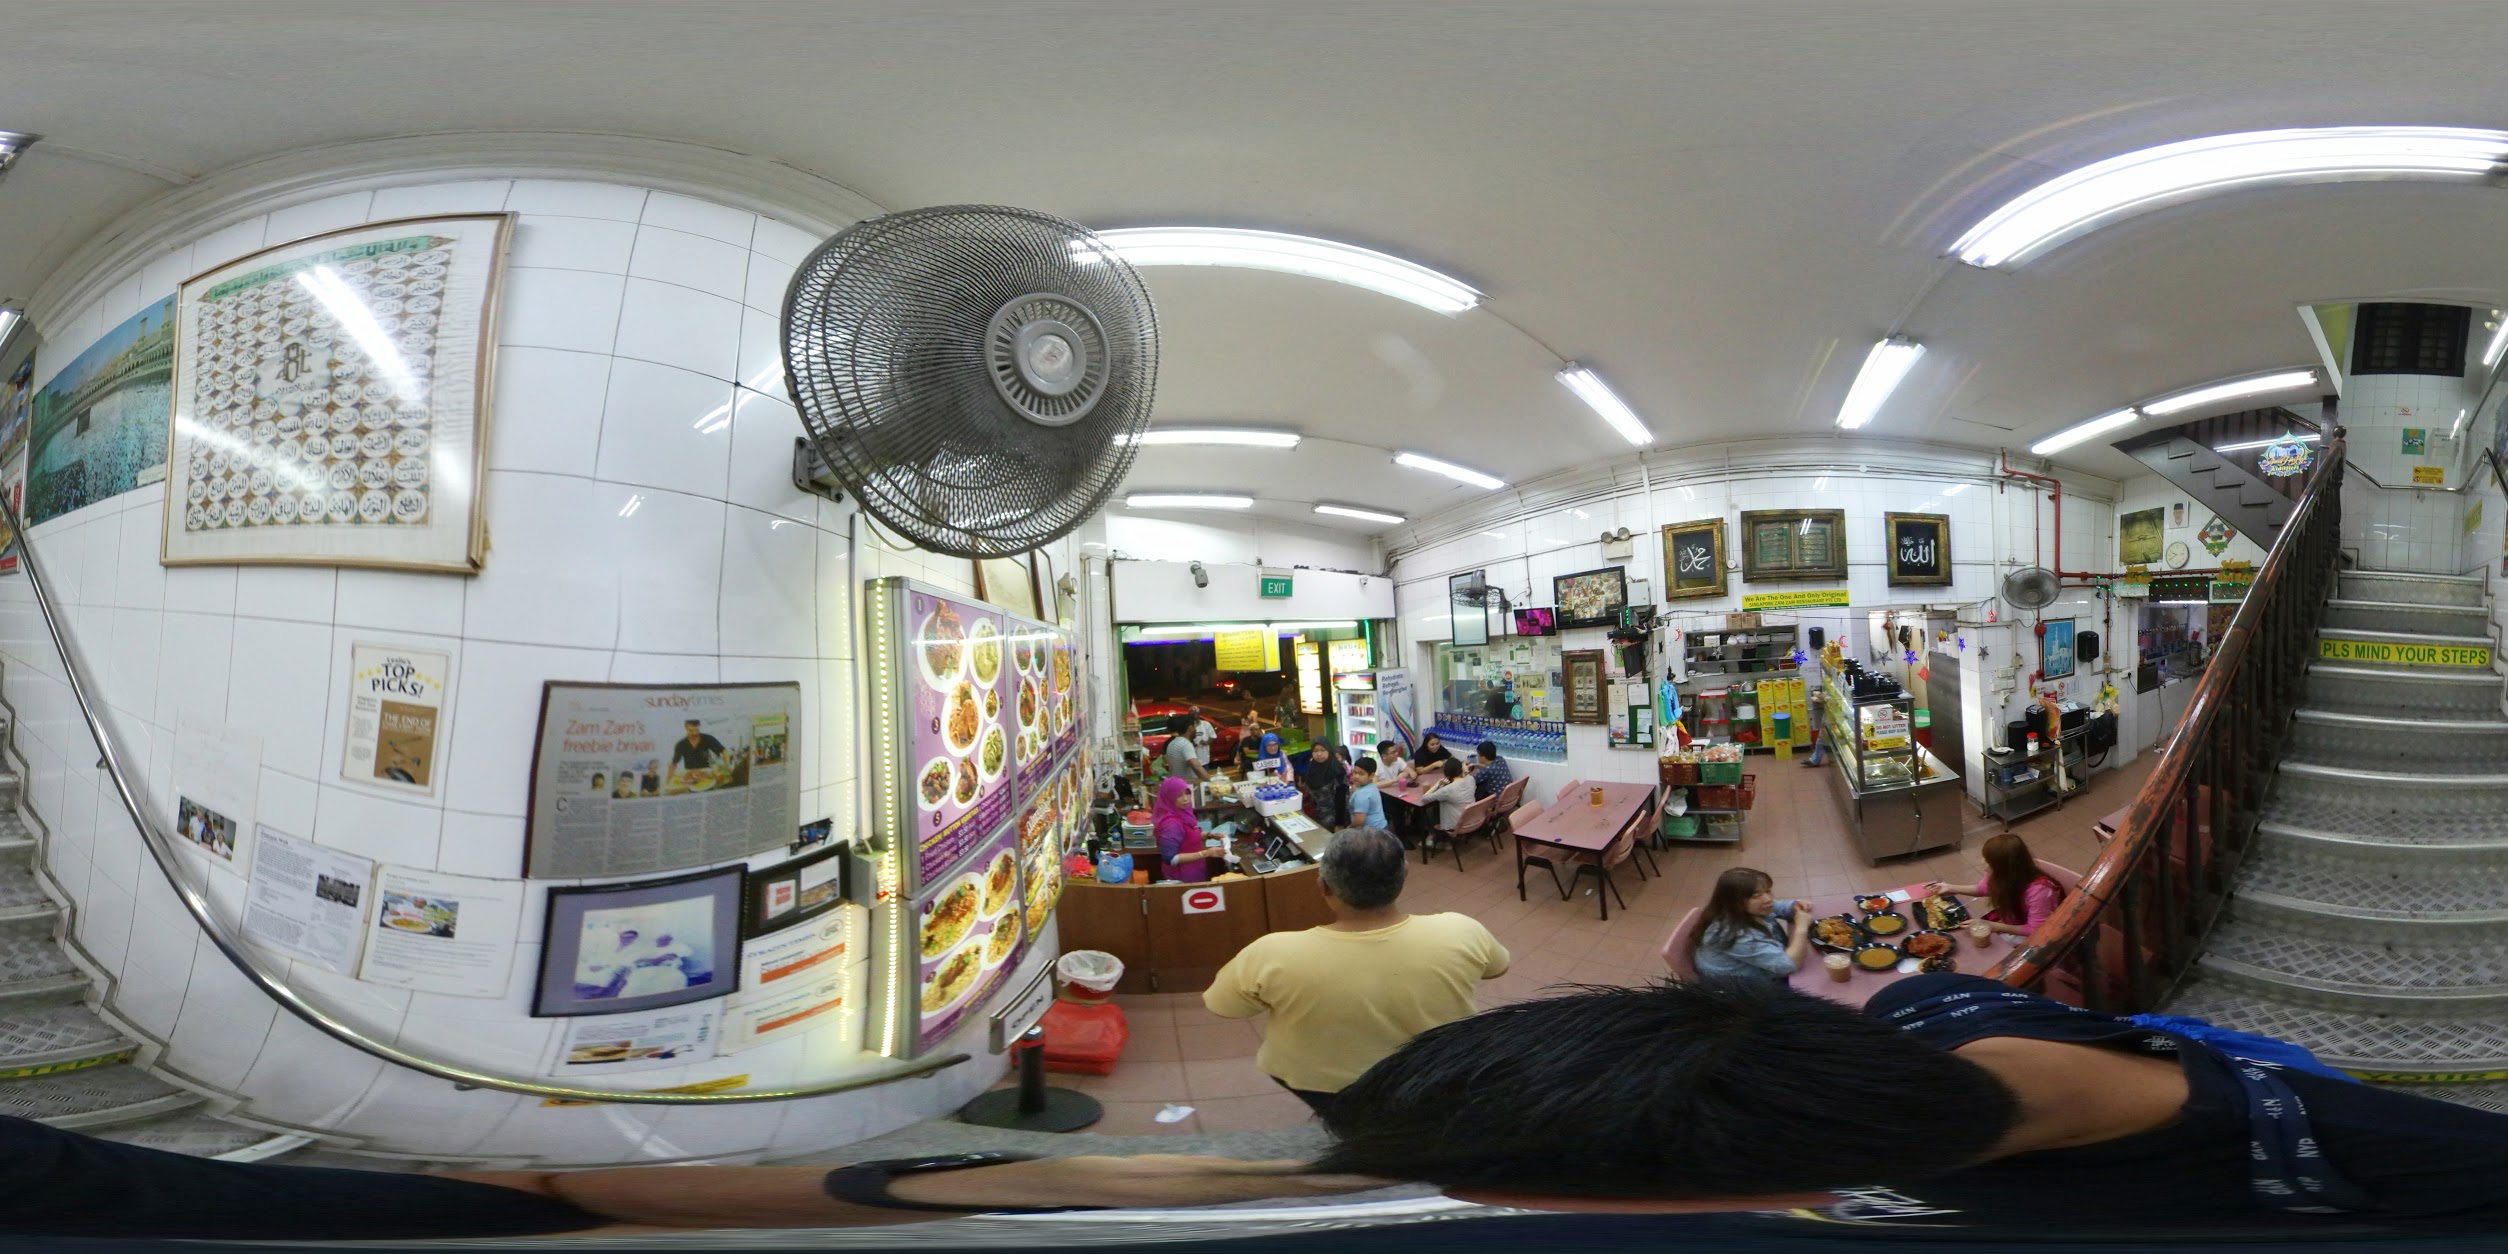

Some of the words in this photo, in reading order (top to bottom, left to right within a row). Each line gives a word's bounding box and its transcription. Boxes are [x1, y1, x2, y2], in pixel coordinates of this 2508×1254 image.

[1268, 582, 1286, 594] EXIT
[1822, 591, 1847, 599] Original
[2323, 642, 2350, 658] PLS
[2355, 644, 2391, 661] MIND
[2396, 646, 2437, 663] YOUR
[2441, 648, 2487, 665] STEPS
[382, 663, 415, 679] TOP
[371, 677, 424, 698] PICKS!
[565, 719, 600, 735] Zam
[603, 719, 646, 735] Zam's
[1256, 759, 1278, 769] CASHIER
[1950, 1005, 1980, 1018] NYP
[2296, 1137, 2321, 1158] NYP
